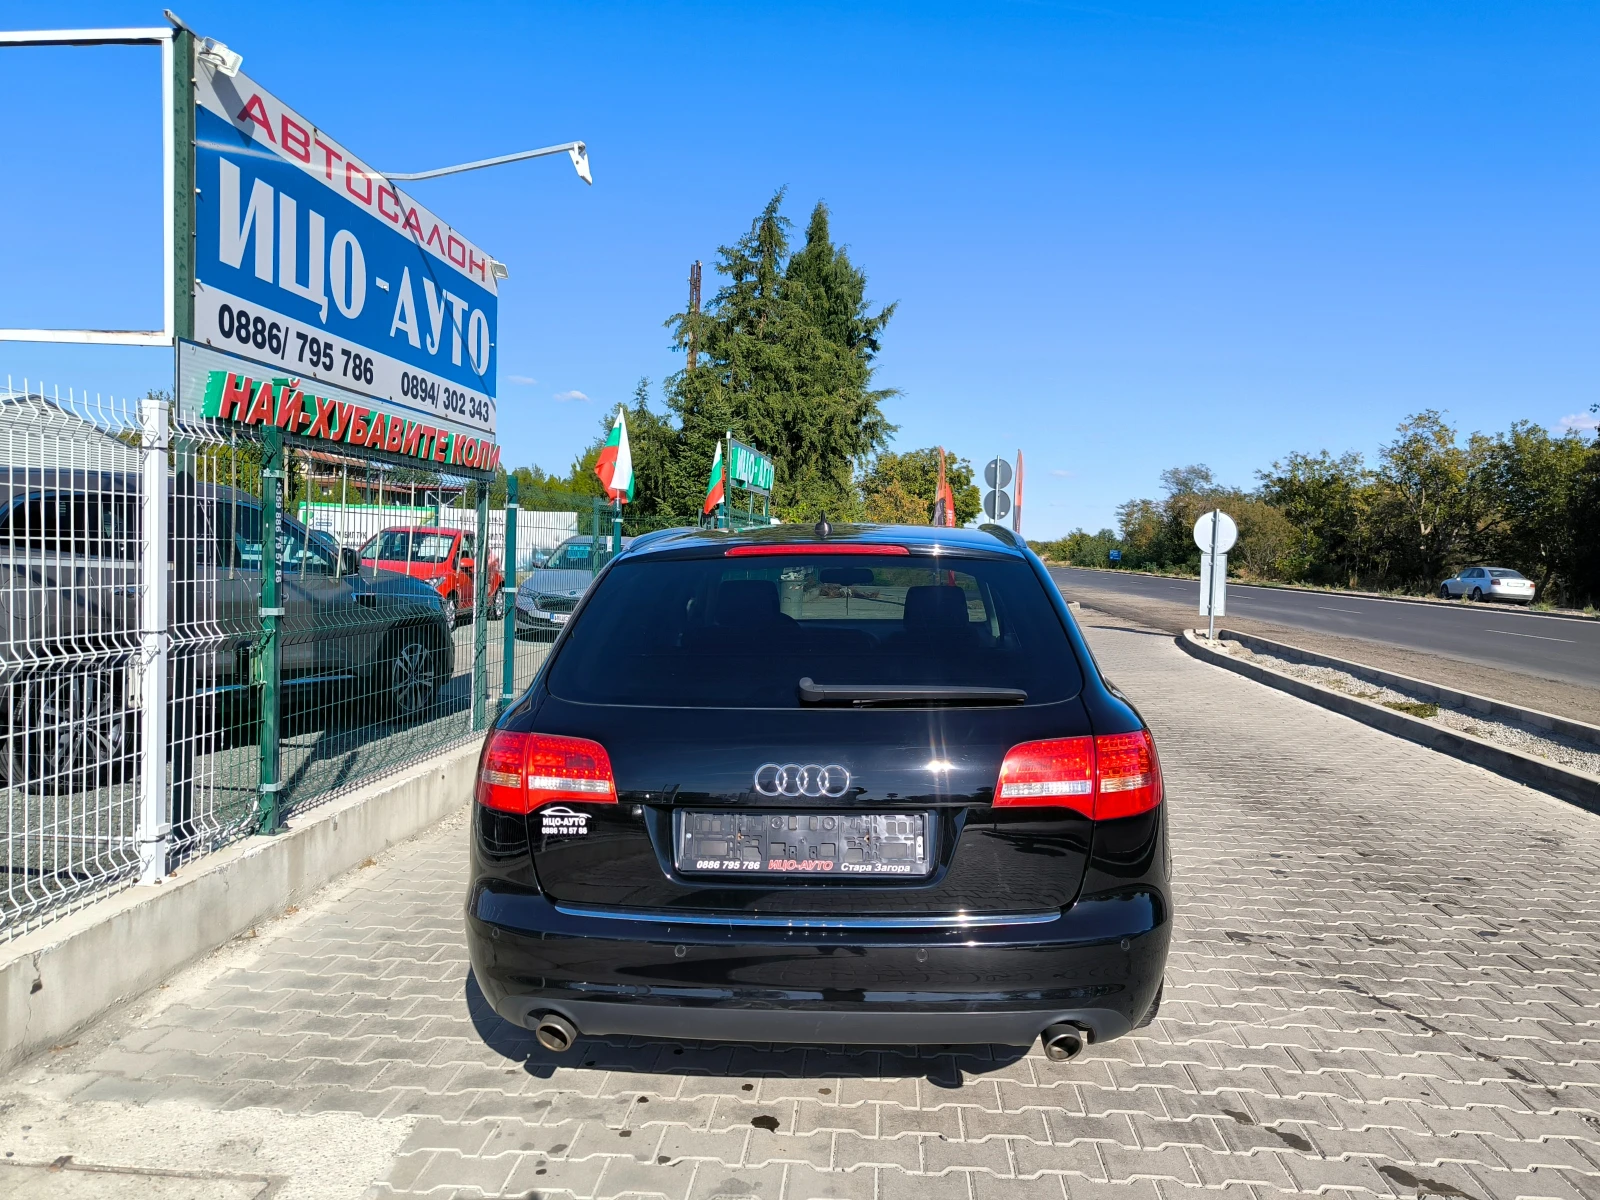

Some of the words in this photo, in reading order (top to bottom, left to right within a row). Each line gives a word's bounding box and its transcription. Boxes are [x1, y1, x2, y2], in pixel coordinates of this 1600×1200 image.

[237, 93, 486, 282] АВТОСАЛОН
[218, 303, 289, 360] 0886/
[296, 331, 334, 372] 795
[341, 348, 374, 385] 786
[401, 371, 440, 409] 0894/
[443, 387, 466, 415] 302
[469, 397, 489, 423] 343
[218, 372, 449, 463] НАЙ-ХУБАВИТЕ
[451, 433, 501, 471] КОЛИ
[275, 536, 282, 549] 79
[275, 570, 282, 583] 86
[542, 817, 586, 827] ИЦО-АУТО
[696, 860, 720, 869] 0886
[722, 861, 740, 870] 795
[742, 861, 760, 870] 786
[768, 859, 834, 871] ИЦО-АУТО
[841, 862, 872, 873] Стара
[874, 863, 911, 873] Загора
